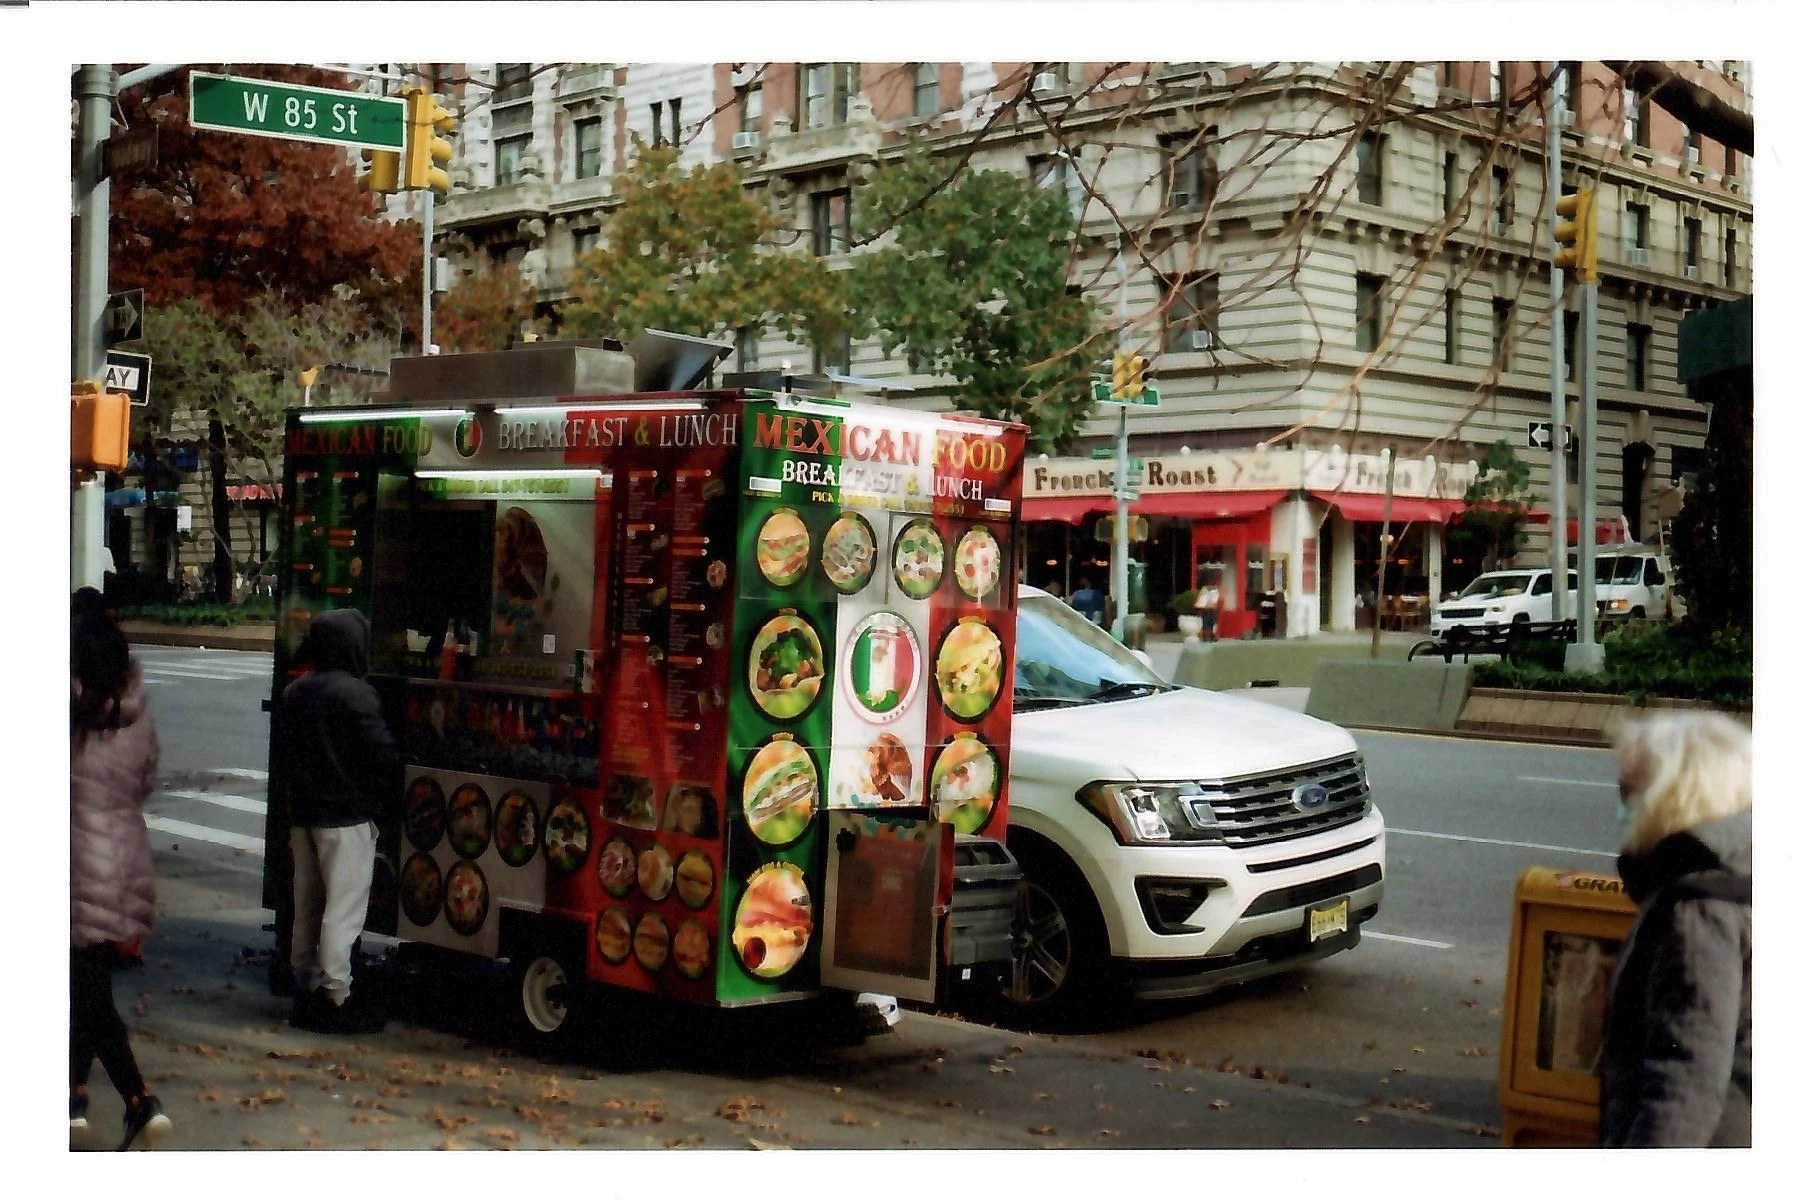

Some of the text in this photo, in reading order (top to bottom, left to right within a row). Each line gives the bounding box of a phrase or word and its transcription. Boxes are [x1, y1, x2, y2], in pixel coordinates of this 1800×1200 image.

[243, 91, 358, 135] W 85 St
[105, 366, 131, 389] AY
[288, 424, 432, 457] MEXICAN FOOD
[498, 413, 738, 451] BREAKFAST & LUNCH
[753, 411, 1007, 474] MEXICAN FOOD
[930, 468, 983, 500] LUNCH
[1147, 460, 1217, 486] Roast
